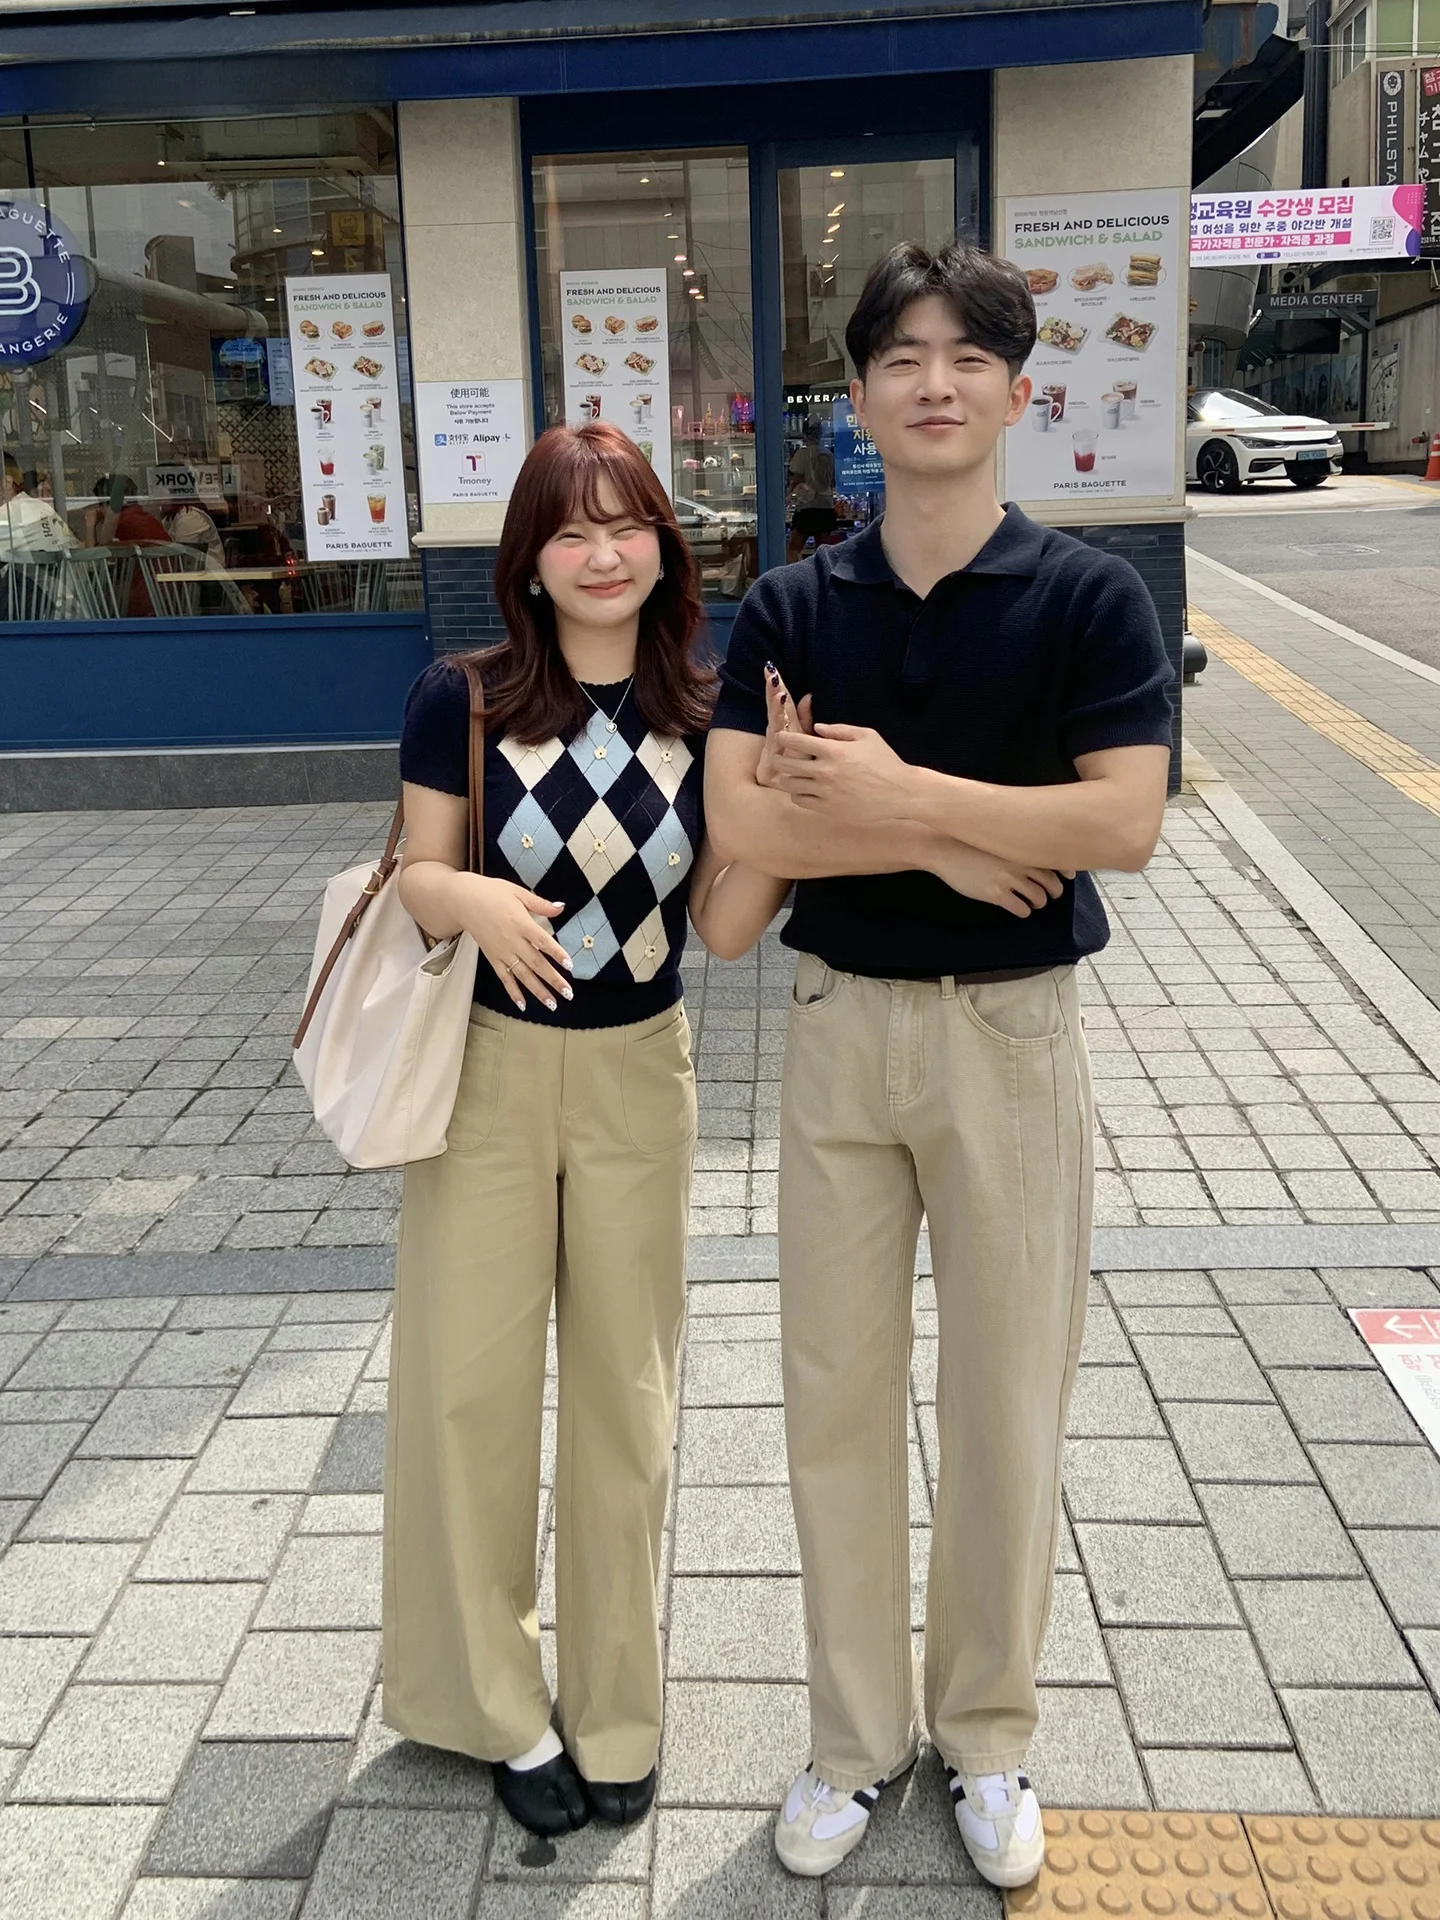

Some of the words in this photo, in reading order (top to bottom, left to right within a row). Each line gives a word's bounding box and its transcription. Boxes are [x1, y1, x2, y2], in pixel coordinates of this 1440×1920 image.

[1257, 197, 1313, 217] 수강생
[1318, 195, 1354, 215] 모집
[1015, 222, 1060, 233] FRESH
[1064, 219, 1093, 230] AND
[1096, 215, 1170, 228] DELICIOUS
[1202, 223, 1235, 234] 여성을
[1239, 222, 1262, 233] 위한
[1265, 221, 1287, 232] 주중
[1291, 219, 1326, 231] 야간반
[1331, 218, 1352, 229] 개설
[1015, 235, 1094, 249] SANDWICH
[1098, 233, 1109, 244] &
[1113, 231, 1163, 243] SALAD
[1191, 238, 1242, 250] 국가자격증
[1314, 233, 1335, 245] 과정
[616, 286, 661, 294] DELICIOUS
[342, 292, 386, 300] DELICIOUS
[567, 298, 616, 306] SANDWICH
[618, 297, 624, 305] &
[627, 296, 657, 304] SALAD
[1270, 296, 1309, 307] MEDIA
[1312, 293, 1363, 305] CENTER
[294, 303, 342, 311] SANDWICH
[344, 302, 351, 310] &
[353, 301, 383, 309] SALAD
[450, 387, 490, 398] 使用可能
[449, 433, 469, 441] 支付宝
[473, 434, 501, 443] Alipay
[458, 476, 492, 486] Tmoney
[1054, 481, 1079, 489] PARIS
[1081, 480, 1127, 488] BAGUETTE
[326, 542, 349, 550] PARIS
[351, 541, 393, 549] BAGUETTE
